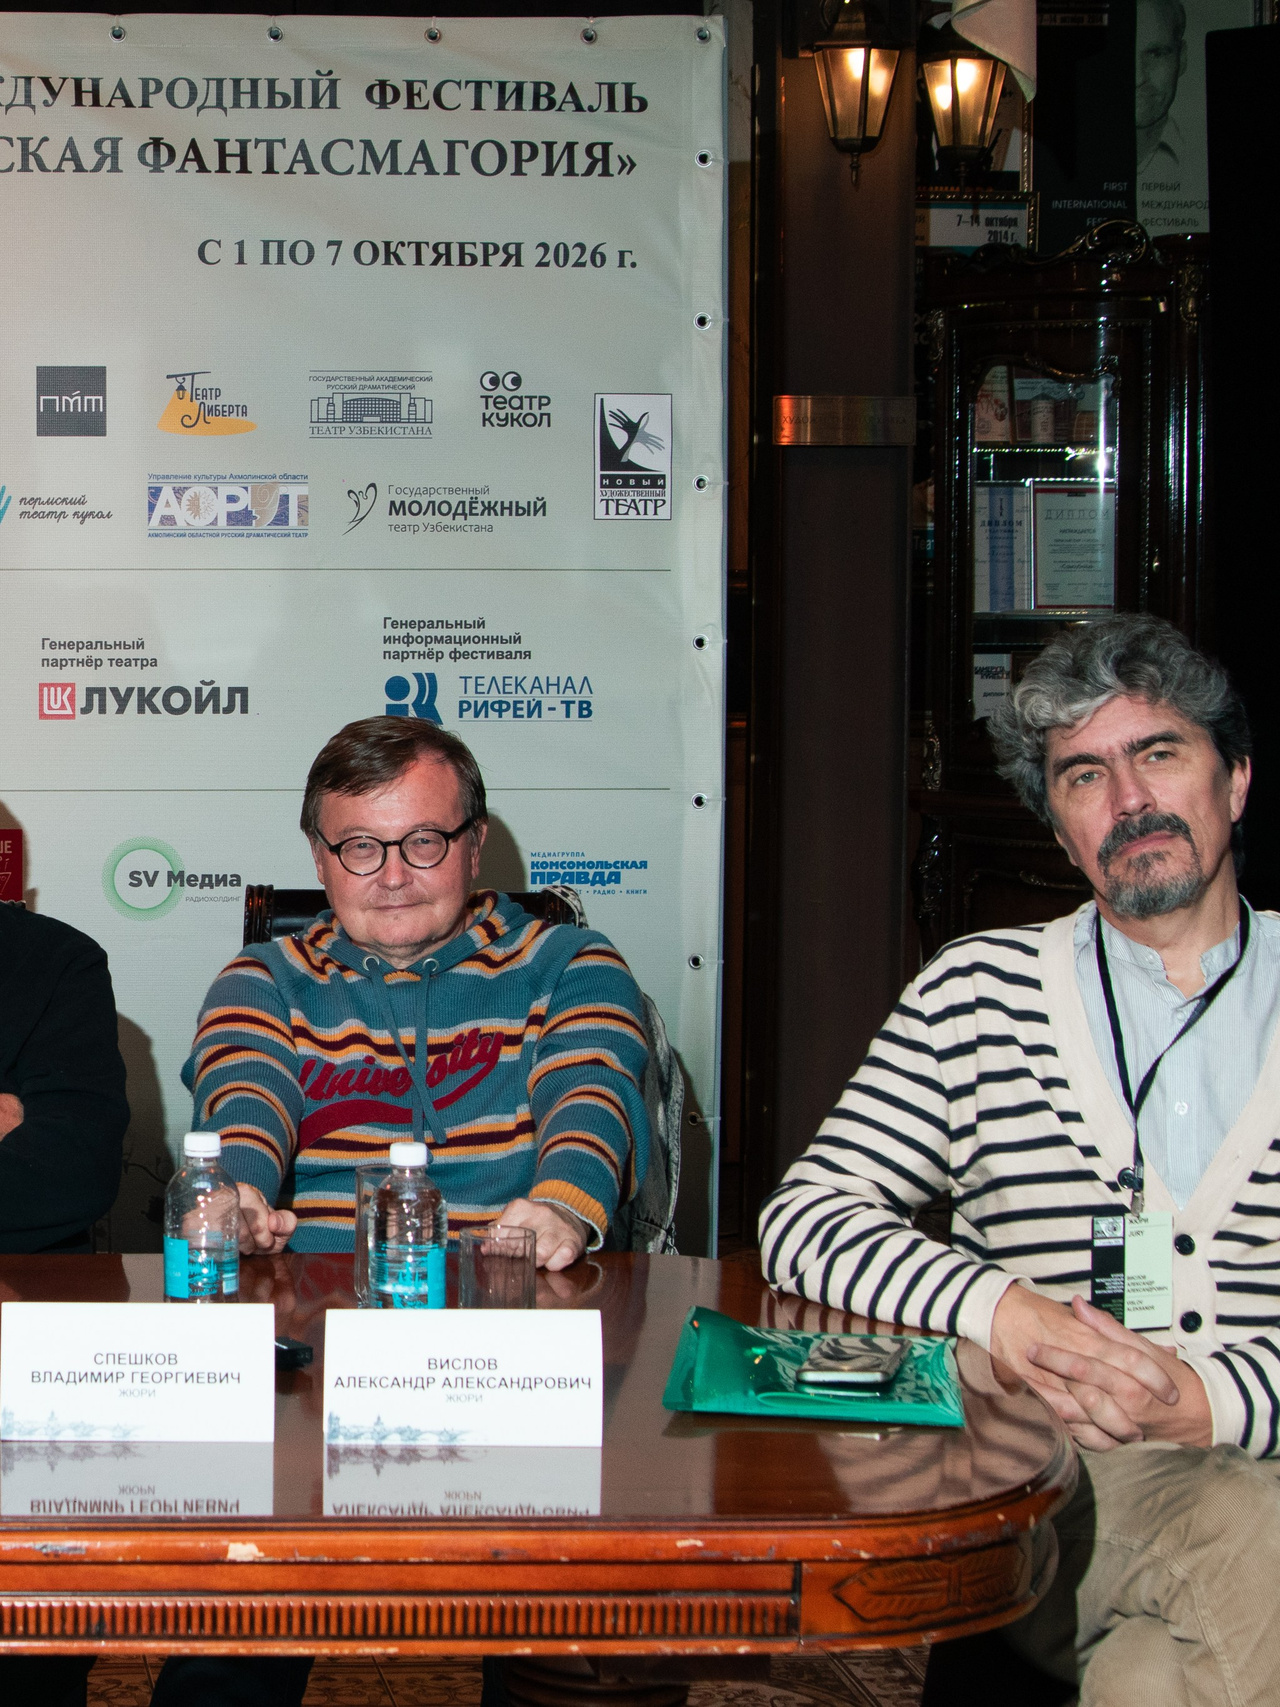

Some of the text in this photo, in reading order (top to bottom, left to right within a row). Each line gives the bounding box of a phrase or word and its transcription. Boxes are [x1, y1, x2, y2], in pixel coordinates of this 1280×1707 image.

[365, 78, 649, 114] ФЕСТИВАЛЬ
[136, 135, 638, 178] ФАНТАСМАГОРИЯ»
[1103, 182, 1128, 192] FIRST
[1141, 181, 1181, 192] ПЕРВЫЙ
[1052, 200, 1128, 209] INTERNATIONAL
[1141, 199, 1210, 210] МЕЖДУНАРОД
[985, 215, 1018, 228] октября
[1142, 216, 1200, 227] ФЕСТИВАЛЬ
[988, 230, 1010, 243] 2014
[198, 239, 638, 270] С 1 ПО 7 ОКТЯБРЯ 2026 г.
[309, 425, 432, 435] ТЕАТР УЗБЕКИСТАНА
[148, 473, 192, 481] Управление
[388, 485, 490, 496] Государственный
[600, 489, 666, 498] ХУДОЖЕСТВЕННЫЙ
[19, 494, 88, 508] пермский
[600, 499, 666, 515] ТЕАТР
[388, 497, 547, 520] МОЛОДЁЖНЫЙ
[19, 510, 113, 525] театр кукол
[388, 522, 494, 535] театр Узбекистана
[383, 617, 486, 631] Генеральный
[41, 637, 145, 652] Генеральный
[383, 632, 522, 647] информационный
[41, 656, 158, 670] партнёр театра
[383, 649, 532, 663] партнёр фестиваля
[459, 676, 593, 695] ТЕЛЕКАНАЛ
[80, 679, 249, 716] ЛУКОЙЛ
[531, 860, 648, 870] КОМСОМОЛЬСКАЯ
[128, 870, 242, 890] SV Медиа
[530, 871, 622, 887] ПРАВДА
[94, 1353, 178, 1366] СПЕШКОВ
[427, 1358, 498, 1370] ВИСЛОВ
[31, 1371, 240, 1385] ВЛАДИМИР ГЕОРГИЕВИЧ
[334, 1376, 592, 1390] АЛЕКСАНДР АЛЕКСАНДРОВИЧ
[118, 1388, 156, 1398] ЖЮРИ
[446, 1393, 484, 1403] ЖЮРИ
